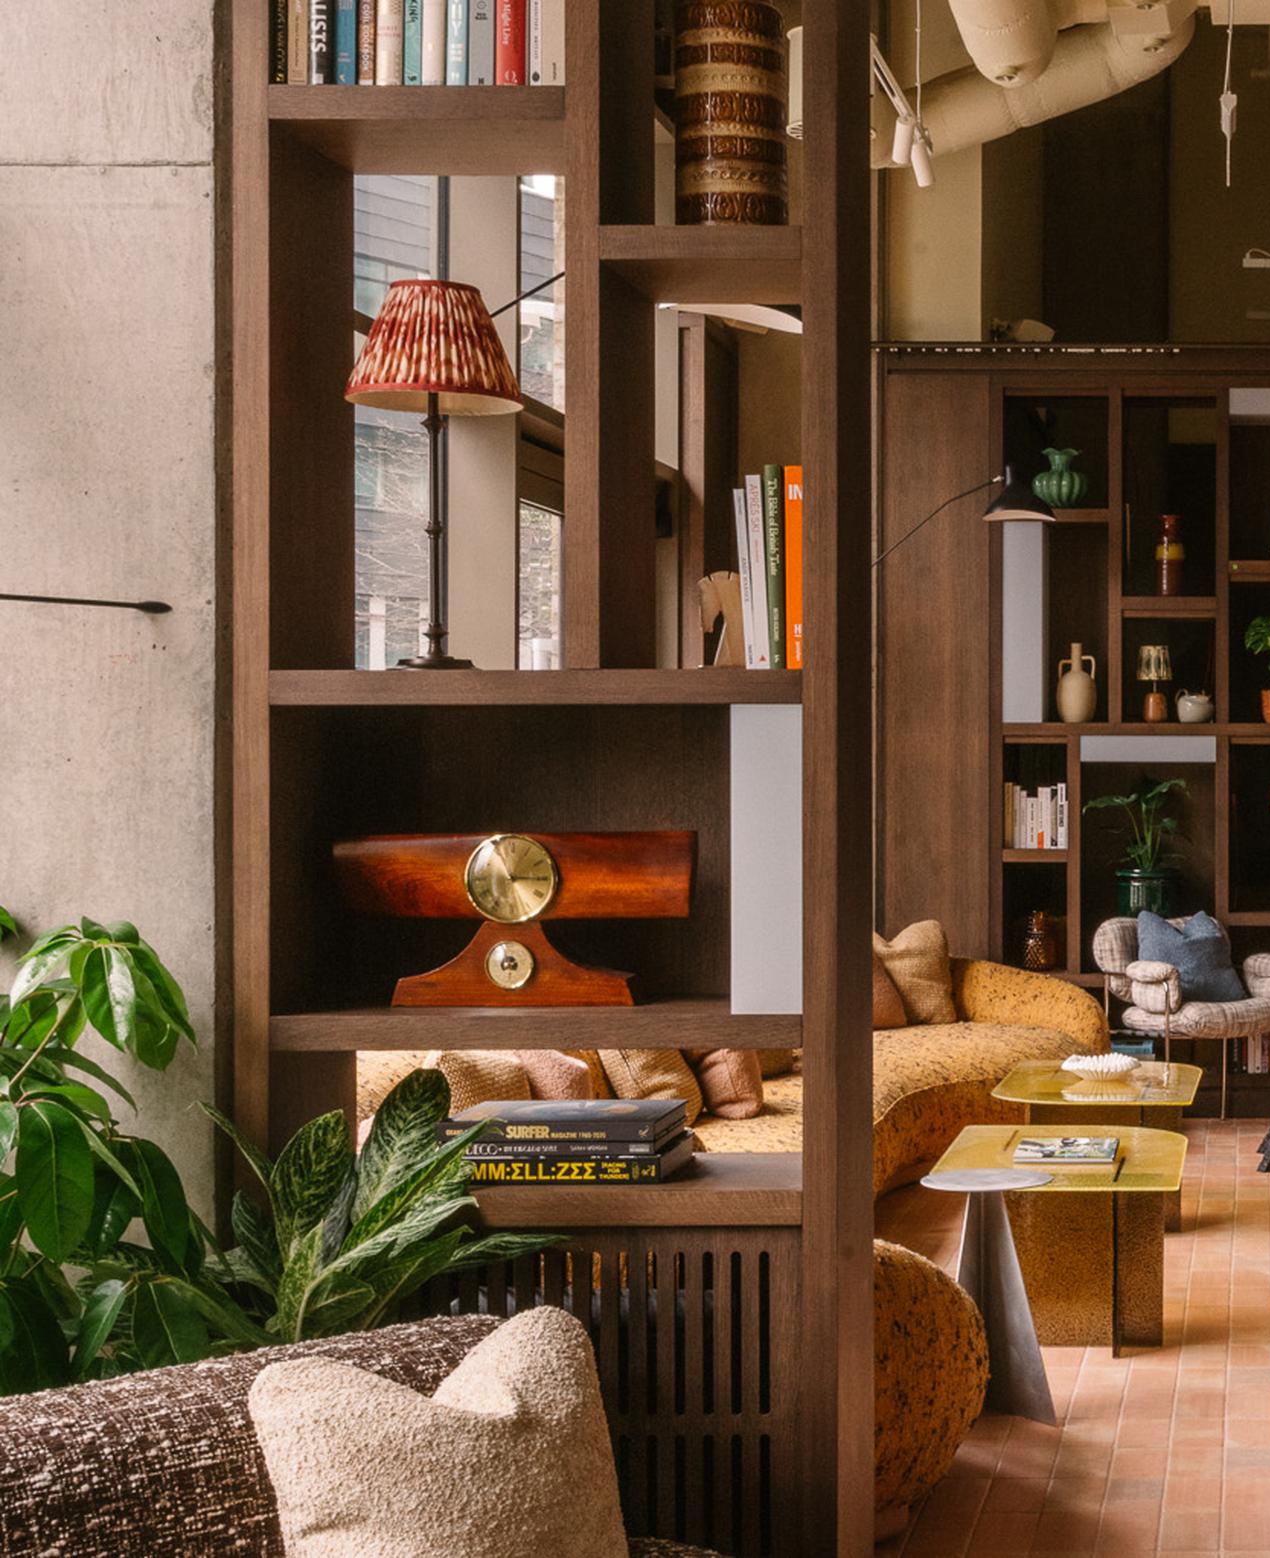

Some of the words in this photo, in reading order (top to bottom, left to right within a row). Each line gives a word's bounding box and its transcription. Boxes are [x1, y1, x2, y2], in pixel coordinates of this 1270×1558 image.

[407, 0, 418, 24] KING
[767, 479, 777, 496] The
[768, 497, 777, 516] Bible
[769, 517, 778, 527] of
[770, 528, 779, 553] British
[771, 554, 780, 576] Taste
[505, 1125, 550, 1139] SURFER
